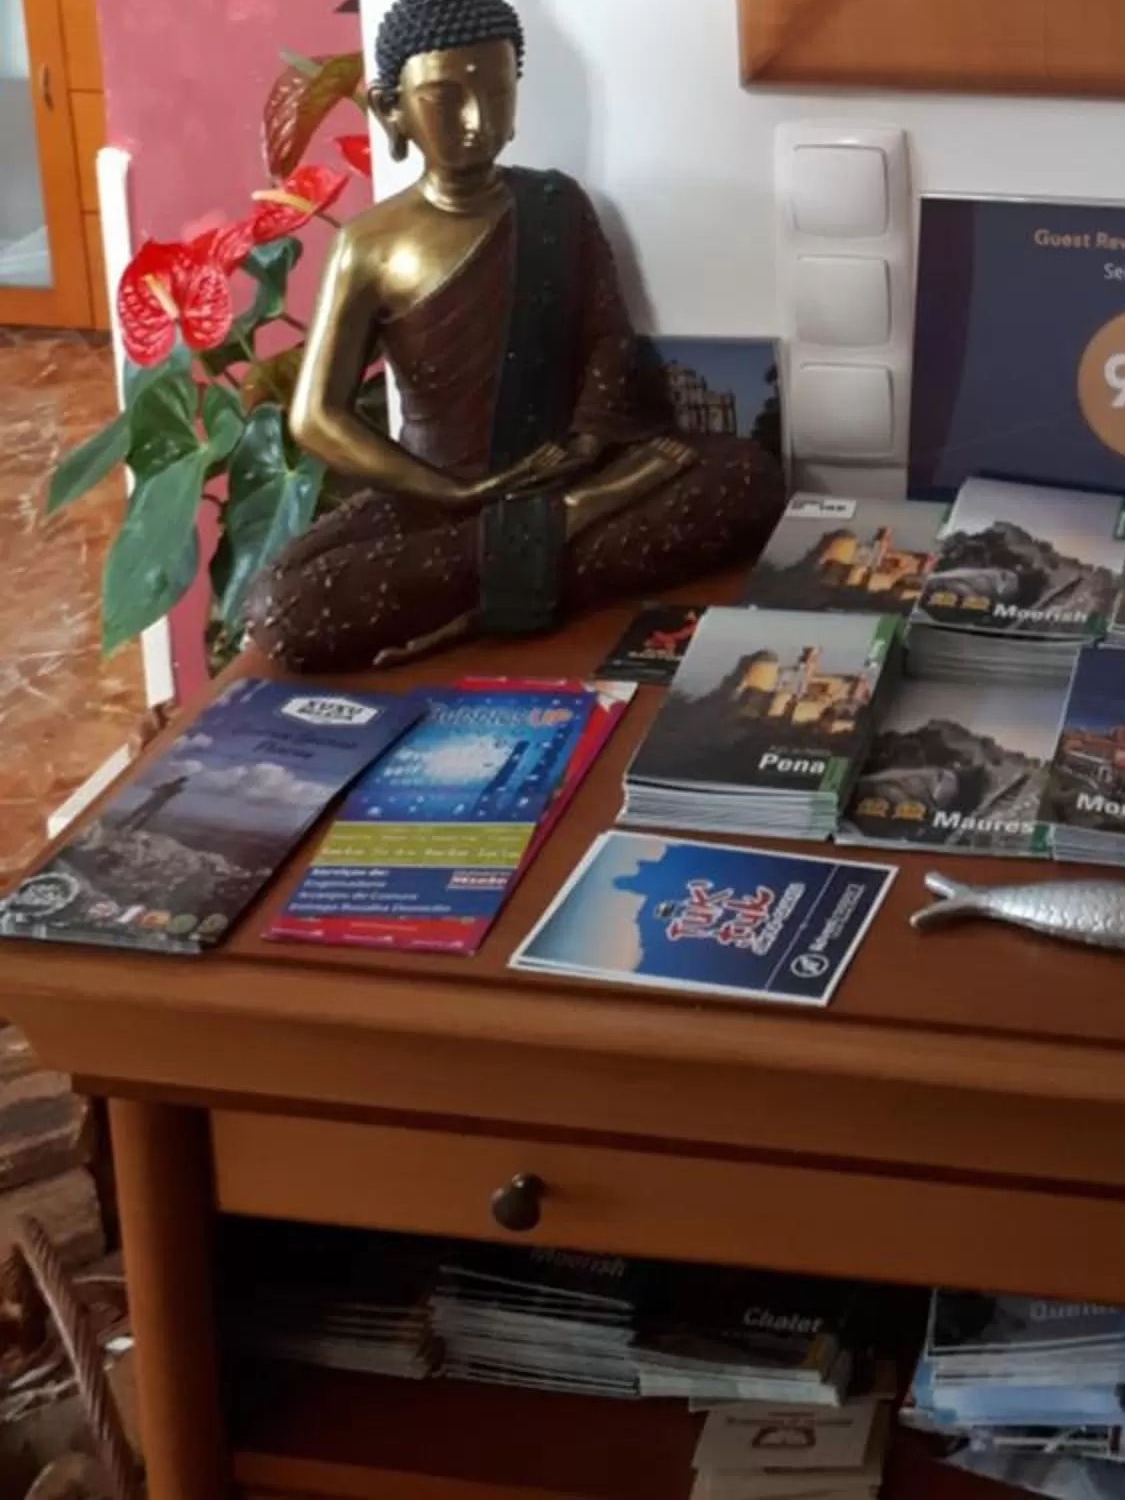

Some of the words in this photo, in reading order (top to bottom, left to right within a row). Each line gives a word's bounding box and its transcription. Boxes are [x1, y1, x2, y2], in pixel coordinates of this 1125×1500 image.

[1034, 228, 1090, 248] Guest
[757, 751, 827, 776] Pena
[741, 1306, 825, 1333] Chalet
